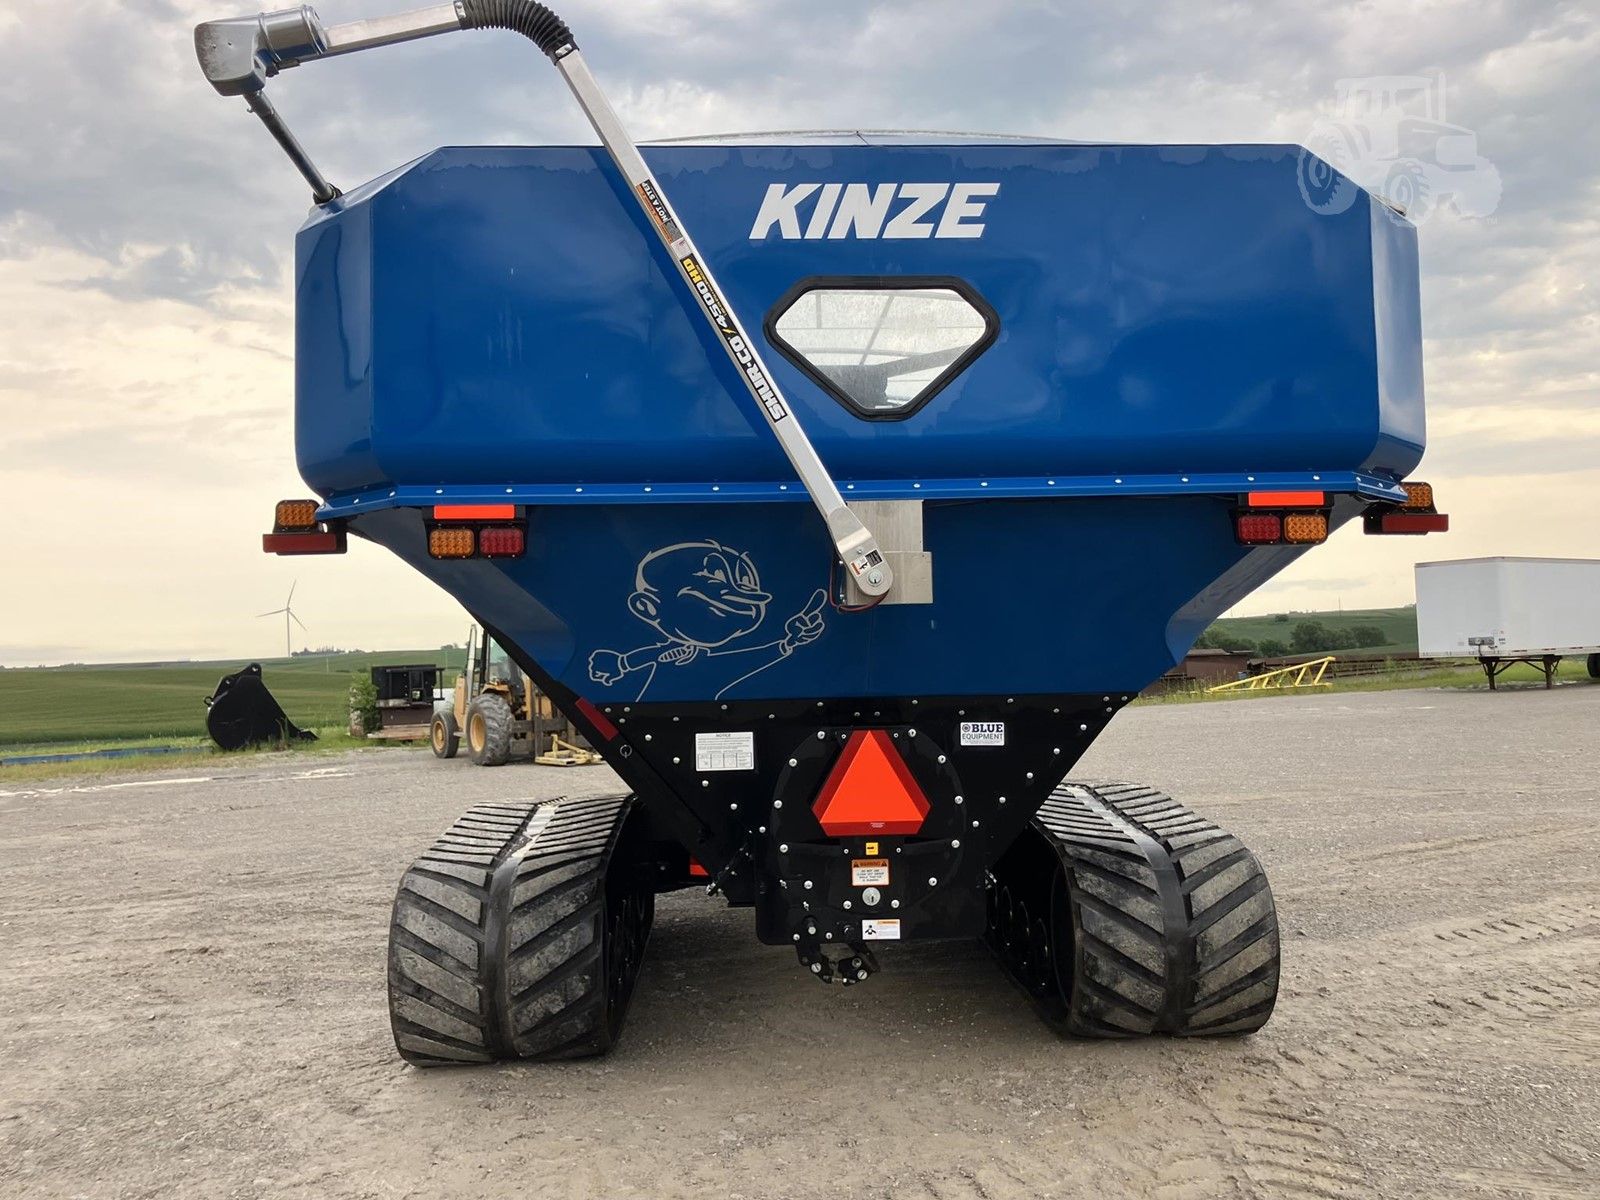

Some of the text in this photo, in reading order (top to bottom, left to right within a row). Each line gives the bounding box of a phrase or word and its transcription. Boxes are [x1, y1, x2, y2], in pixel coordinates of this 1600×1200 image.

[642, 182, 656, 200] STEP
[655, 205, 669, 222] NOT
[749, 183, 1000, 240] KINZE
[682, 258, 728, 329] 4500HD
[971, 723, 1003, 733] BLUE
[962, 733, 1003, 741] EQUIPMENT
